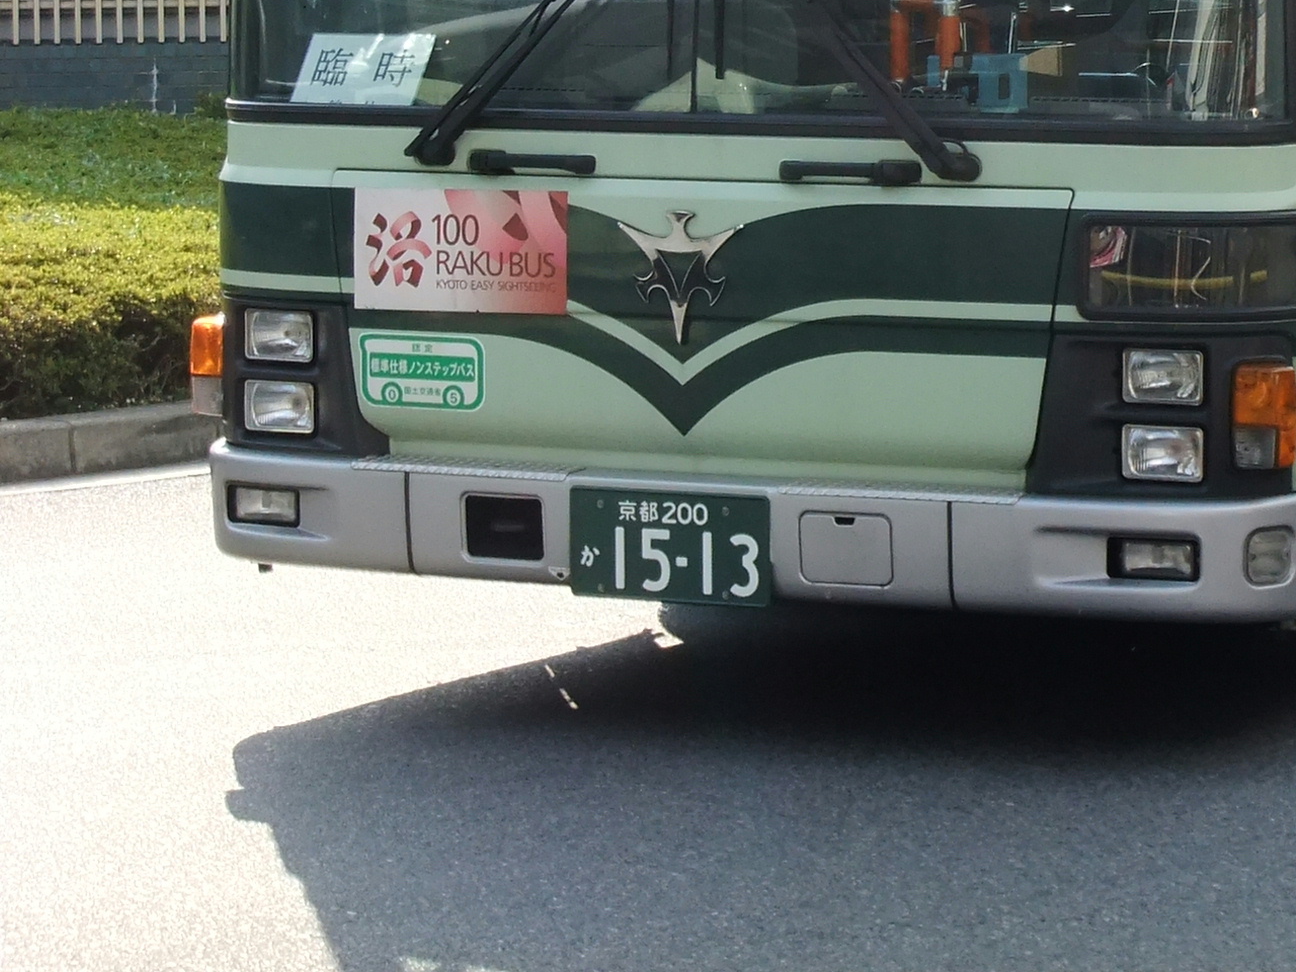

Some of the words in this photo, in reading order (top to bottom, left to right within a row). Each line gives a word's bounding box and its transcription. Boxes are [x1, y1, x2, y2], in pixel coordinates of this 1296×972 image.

[310, 48, 415, 87] 臨時
[431, 214, 480, 246] 100
[436, 250, 503, 277] RAKU
[509, 252, 556, 278] BUS
[436, 280, 468, 291] KYOTO
[470, 281, 495, 292] EASY
[497, 281, 557, 294] SIGHTSEEING
[388, 389, 397, 401] 0
[450, 392, 458, 404] 5
[580, 545, 600, 567] か
[615, 526, 759, 597] 15-13
